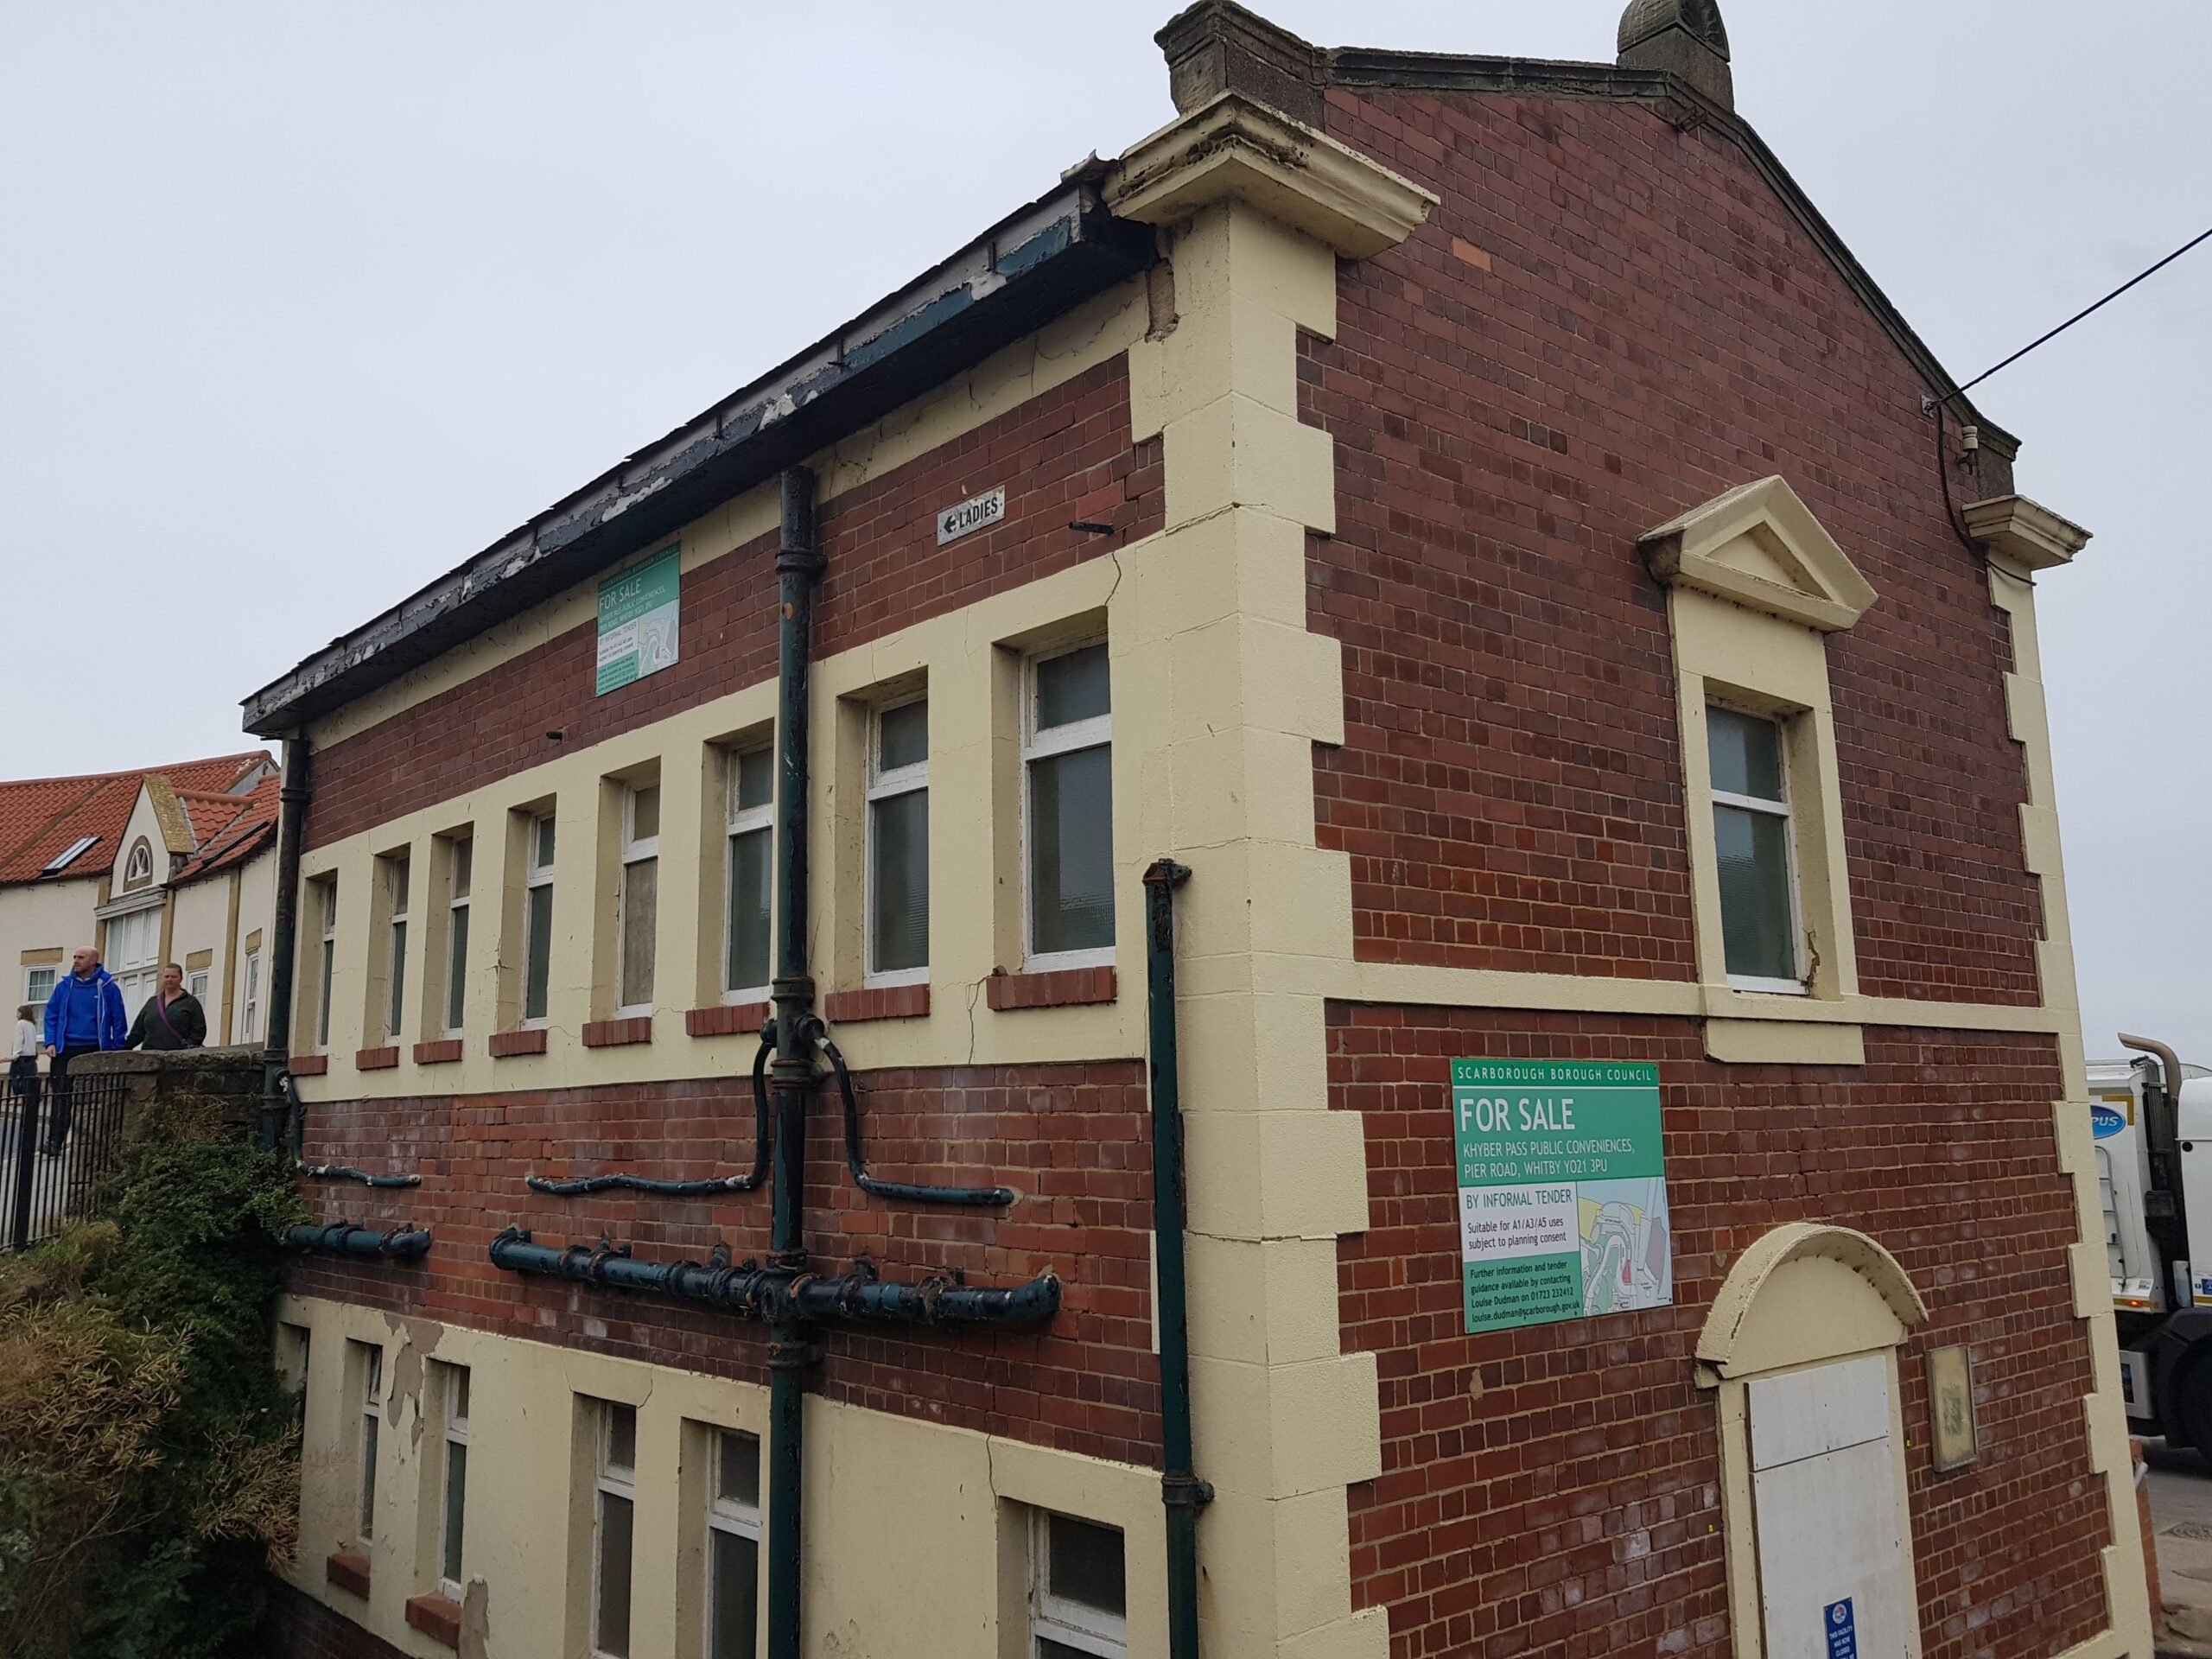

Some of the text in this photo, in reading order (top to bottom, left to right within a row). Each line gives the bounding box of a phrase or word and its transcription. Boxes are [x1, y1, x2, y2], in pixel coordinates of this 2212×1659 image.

[959, 497, 998, 528] LADIES
[600, 577, 641, 613] FOR SALE
[1458, 1066, 1651, 1081] SCARBOROUGH BOROUGH COUNCIL
[1459, 1098, 1576, 1132] FOR SALE
[1463, 1138, 1635, 1158] KHYBER PASS PUBLIC CONVENIENCES,
[1464, 1159, 1607, 1179] PIER ROAD, WHITBY YO21 3PU
[1466, 1189, 1572, 1209] BY INFORMAL TENDER
[1467, 1217, 1563, 1234] Suitable for A1/A3/A5 uses
[1468, 1232, 1567, 1251] subject to planning consent
[1470, 1261, 1567, 1279] Further information and tender
[1471, 1274, 1571, 1295] guidance available by contacting
[1471, 1287, 1573, 1308] Louise Dudman on 01723 232412
[1471, 1300, 1580, 1323] louise.dudman@scarborough.gov.uk
